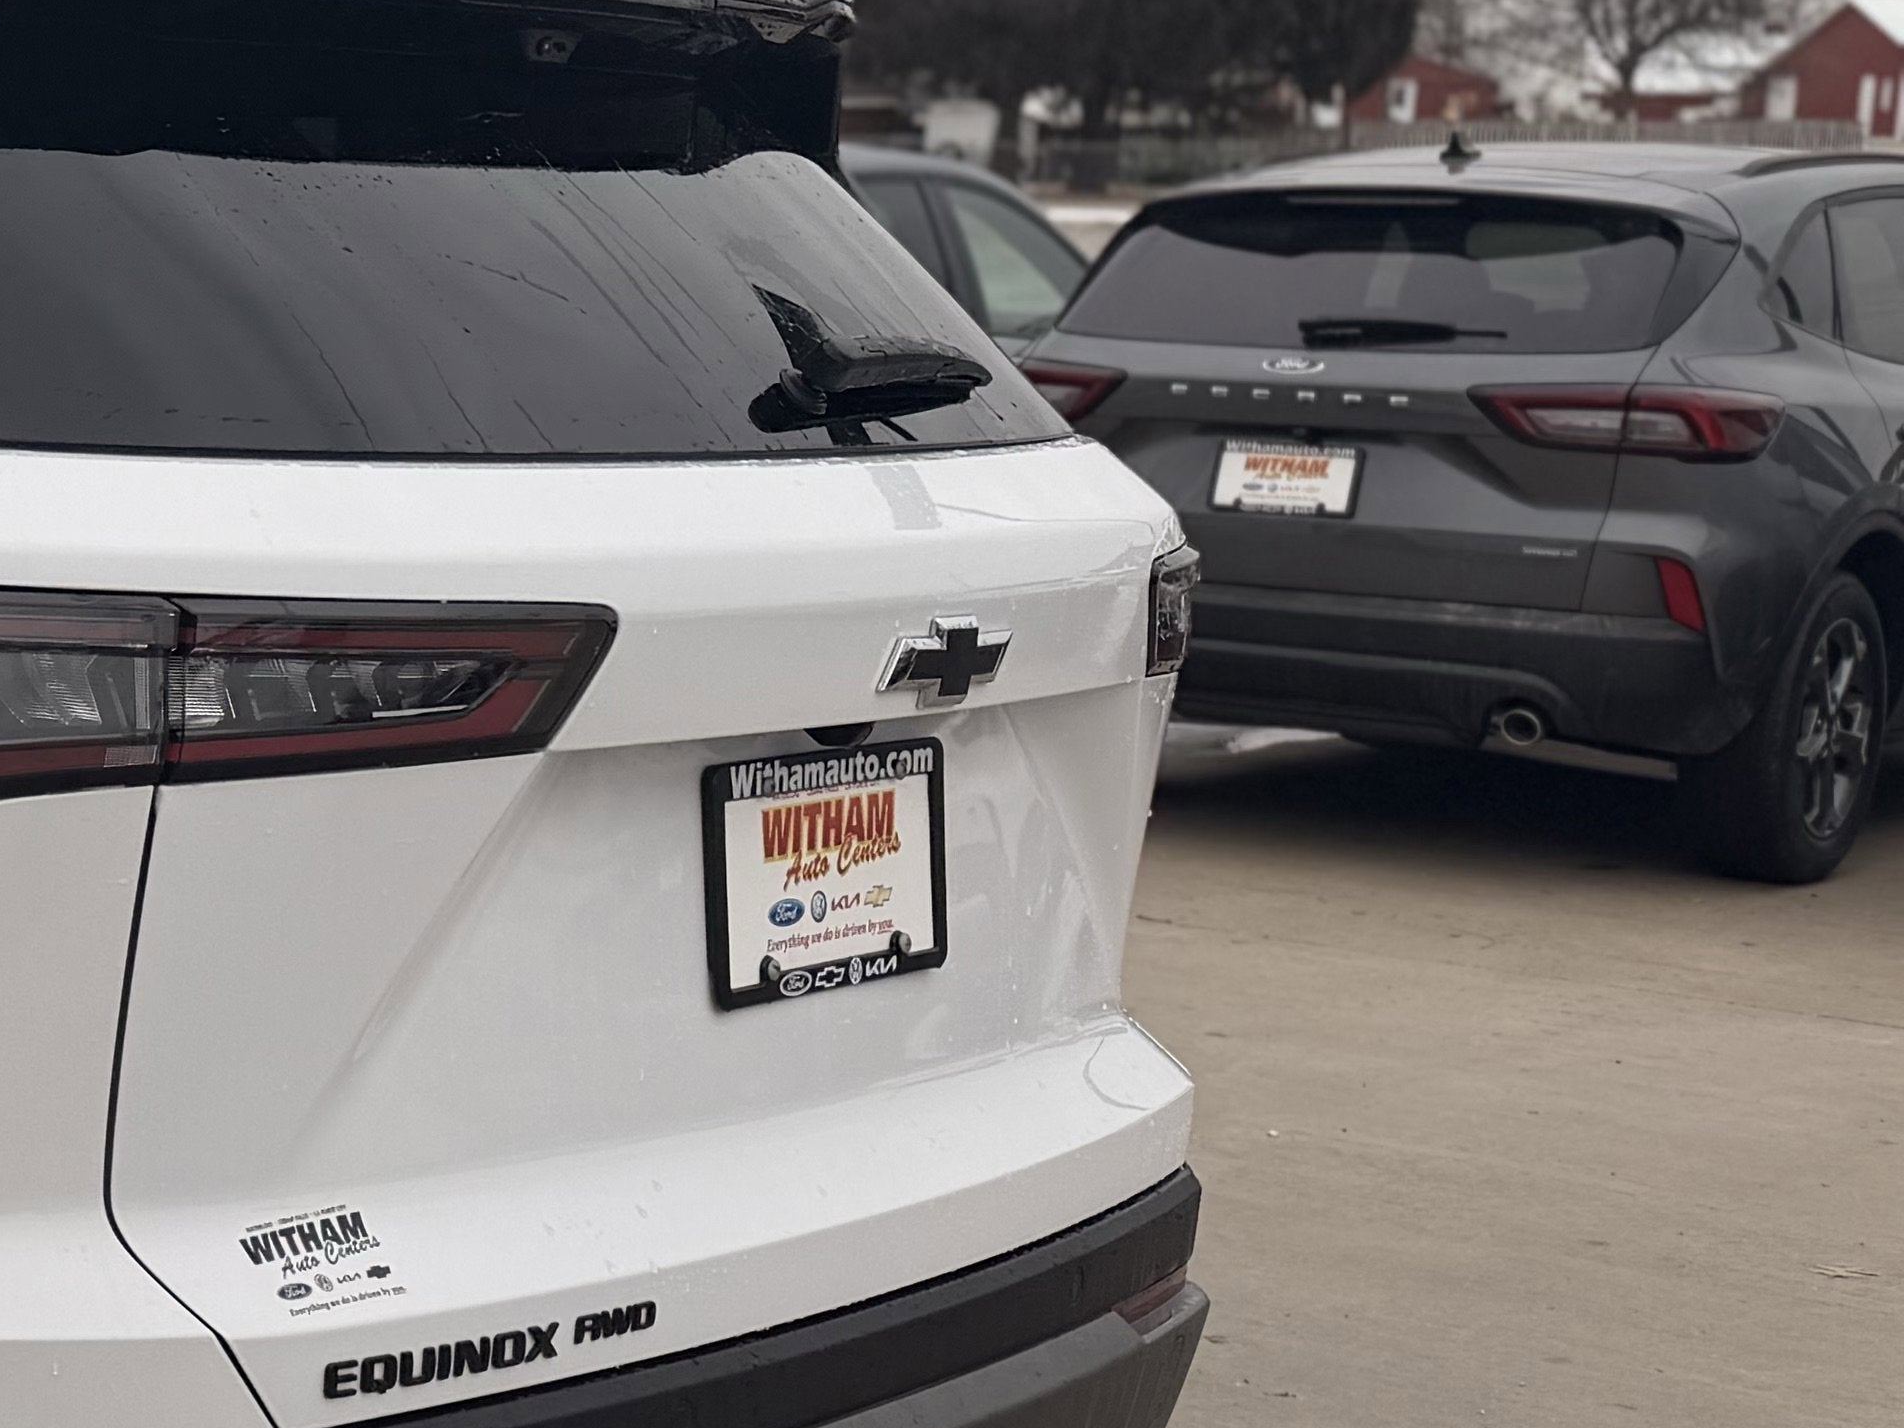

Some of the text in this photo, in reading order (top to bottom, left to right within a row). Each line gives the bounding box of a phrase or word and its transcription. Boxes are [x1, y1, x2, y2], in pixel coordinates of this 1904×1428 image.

[761, 790, 896, 861] WITHAM
[783, 832, 902, 891] Auto Centers
[767, 933, 810, 953] Everything
[239, 1211, 368, 1265] WITHAM
[282, 1236, 380, 1280] Auto Centers
[323, 1300, 656, 1399] EQUINOX AWD
